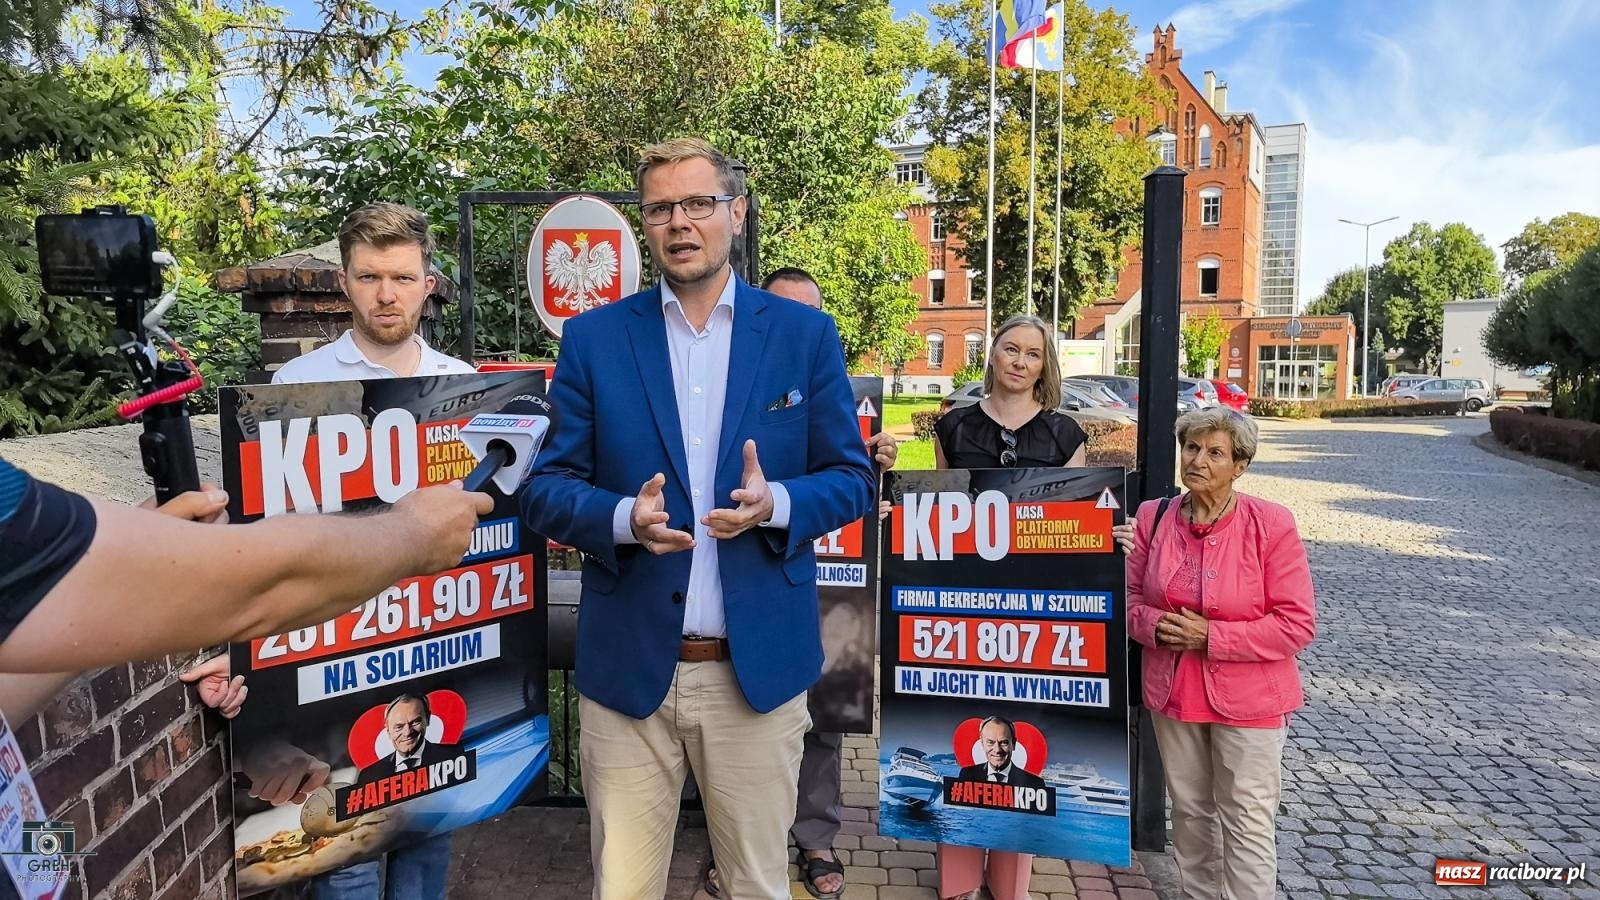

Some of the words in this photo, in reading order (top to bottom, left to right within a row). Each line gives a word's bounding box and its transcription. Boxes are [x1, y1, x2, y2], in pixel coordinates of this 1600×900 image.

[426, 424, 459, 444] KASA
[258, 408, 418, 518] KPO
[426, 442, 474, 464] PLATFO
[903, 490, 1010, 561] KPO
[1016, 505, 1044, 519] KASA
[1016, 520, 1080, 534] PLATFORMY
[464, 522, 513, 557] UNIU
[1016, 534, 1104, 549] OBYWATELSKIEJ
[350, 571, 480, 641] 261,90
[491, 562, 528, 610] ZŁ
[897, 590, 936, 608] FIRMA
[939, 591, 1028, 611] REKREACYJNA
[1031, 594, 1045, 612] W
[1048, 595, 1107, 614] SZTUMIE
[913, 619, 967, 660] 521
[977, 622, 1041, 664] 807
[1051, 625, 1089, 667] ZŁ
[324, 660, 358, 695] NA
[366, 631, 482, 685] SOLARIUM
[901, 670, 923, 692] NA
[928, 672, 979, 695] JACHT
[984, 675, 1007, 698] NA
[1013, 676, 1102, 704] WYNAJEM
[346, 755, 467, 815] #AFERAKPO
[951, 781, 1048, 812] #AFERAKPO
